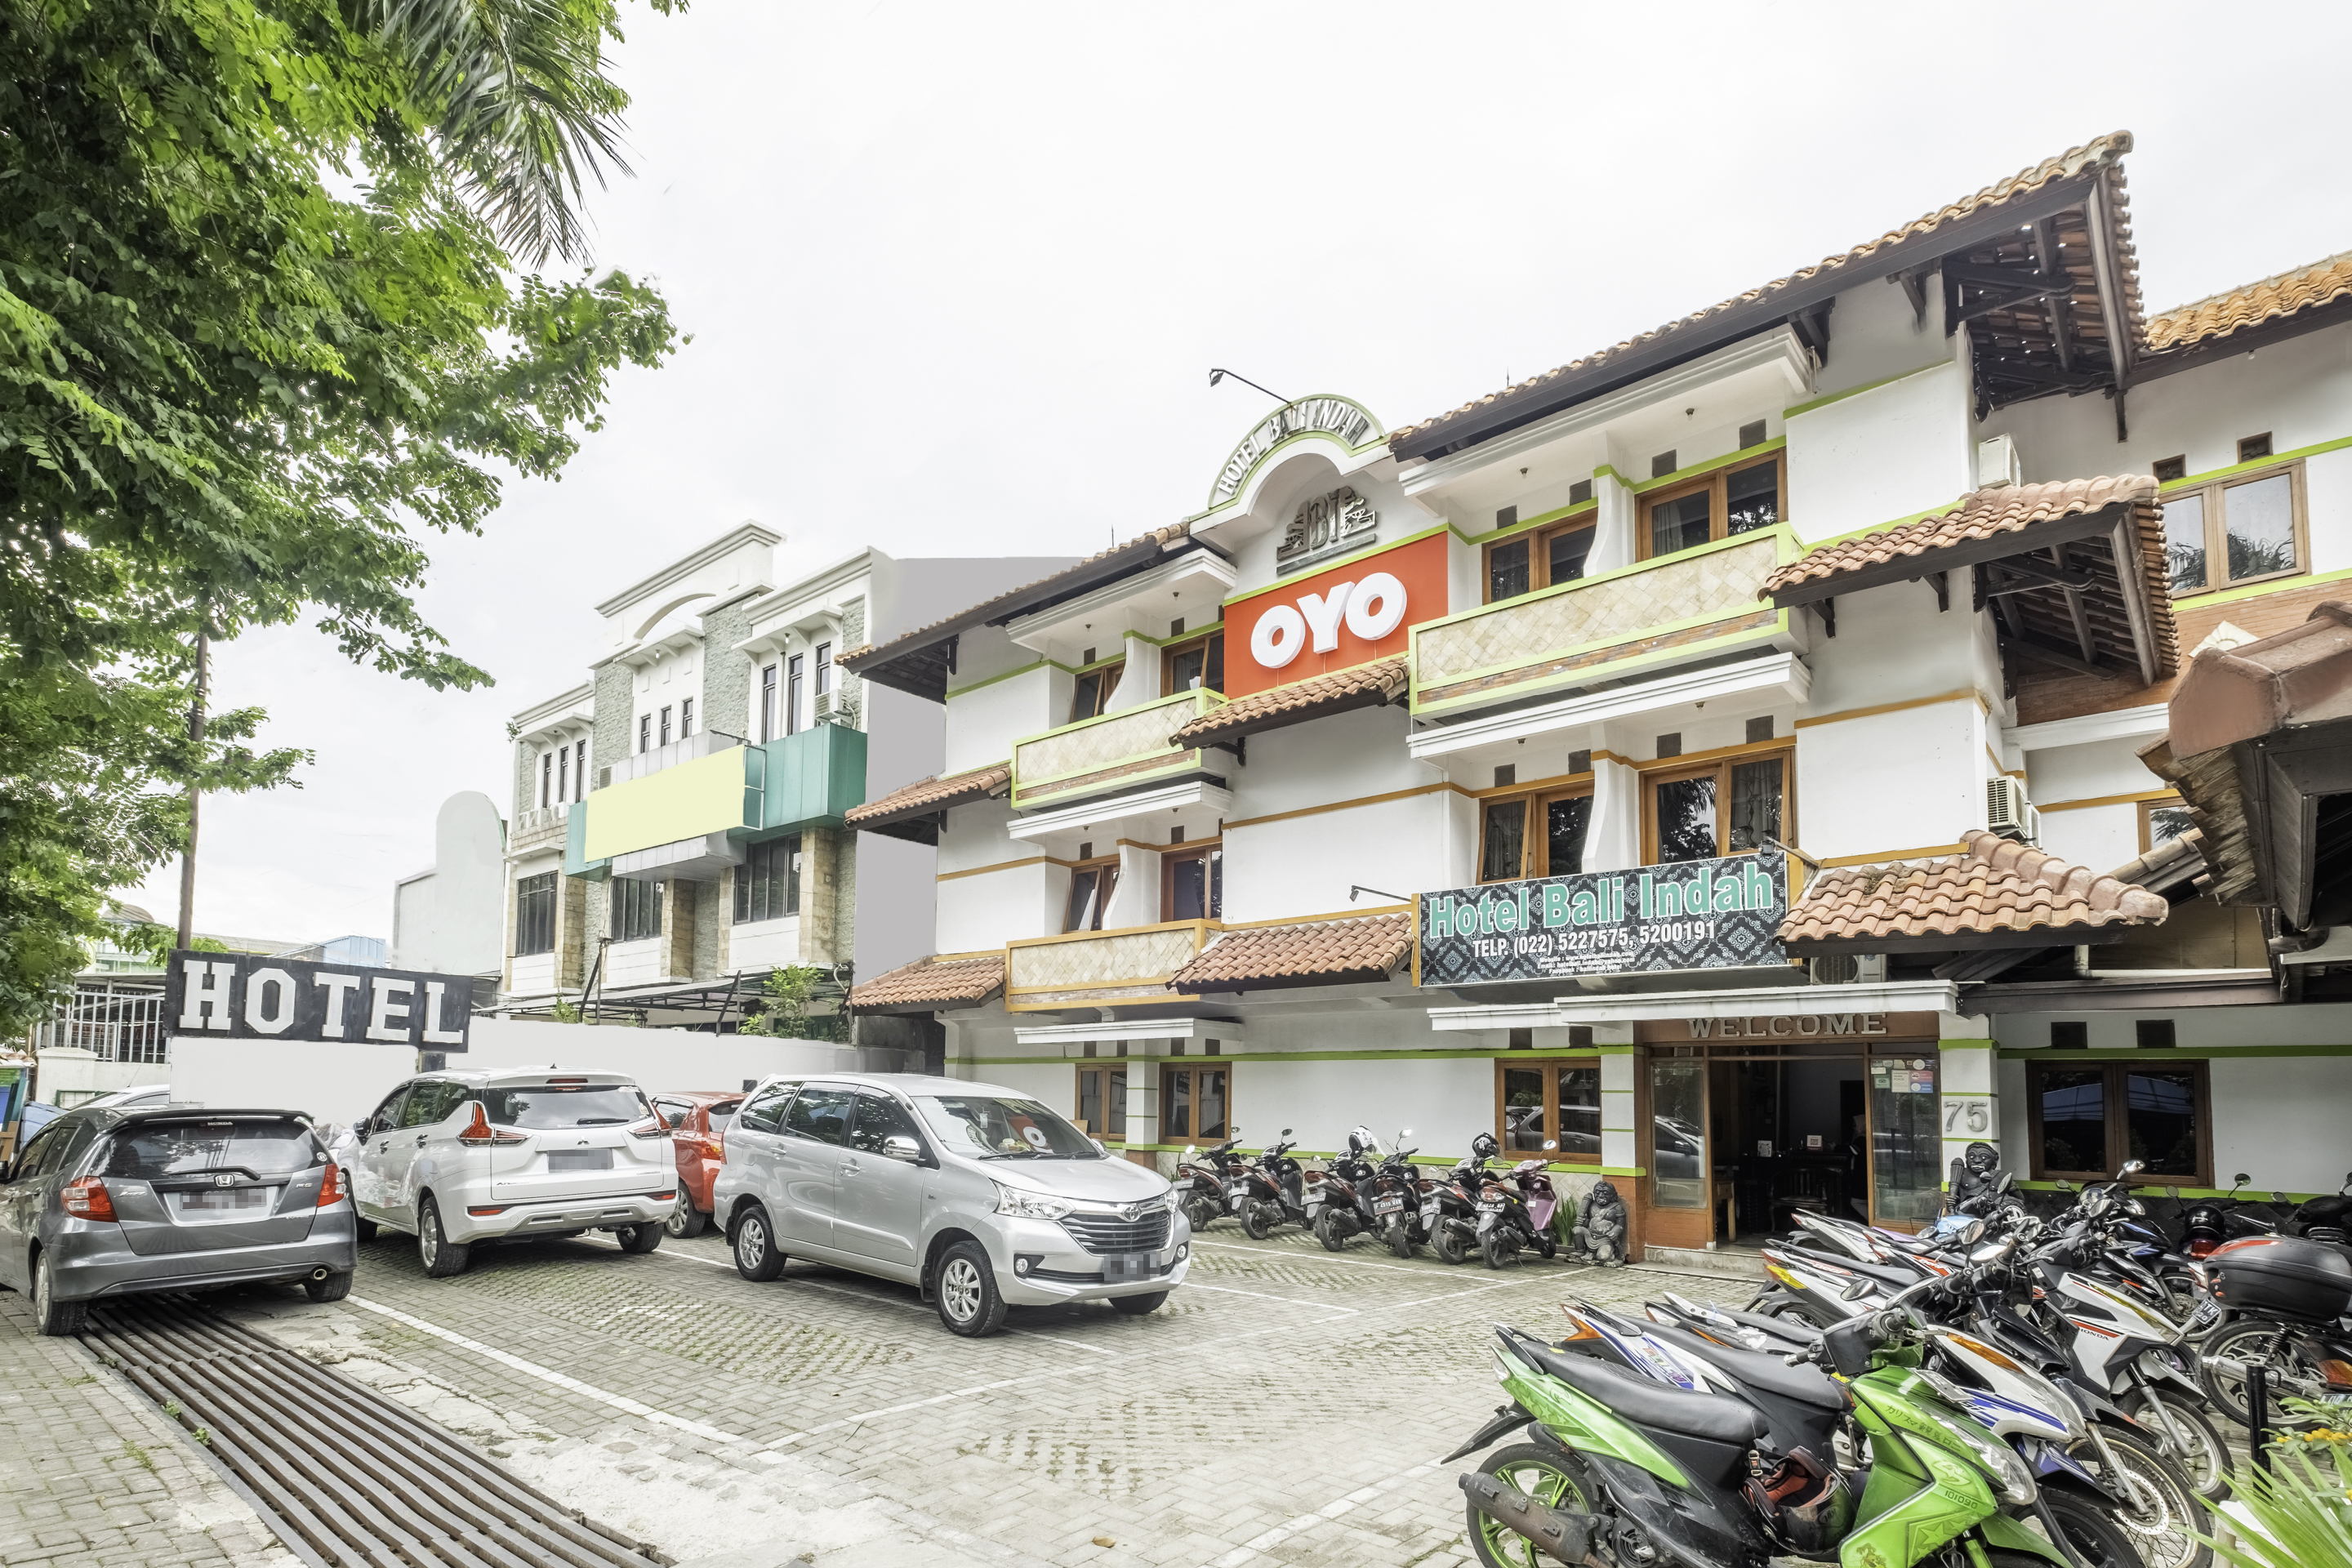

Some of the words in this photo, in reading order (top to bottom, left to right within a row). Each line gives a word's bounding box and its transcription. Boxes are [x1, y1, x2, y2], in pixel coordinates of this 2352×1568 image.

[1218, 434, 1266, 495] HOTEL
[1267, 401, 1309, 443] BALI
[1312, 399, 1370, 446] INDAH
[1250, 572, 1407, 669] OYO
[1429, 887, 1530, 938] Hotel
[1543, 875, 1624, 929] Bali
[1639, 862, 1774, 920] Indah
[1472, 938, 1508, 958] TELP.
[1513, 932, 1552, 959] (022)
[1558, 926, 1634, 951] 5227575,
[1639, 920, 1715, 945] 5200191
[179, 960, 464, 1045] HOTEL
[1686, 1013, 1887, 1038] WELCOME
[1943, 1100, 1988, 1134] 75
[1944, 1490, 1978, 1510] 101090
